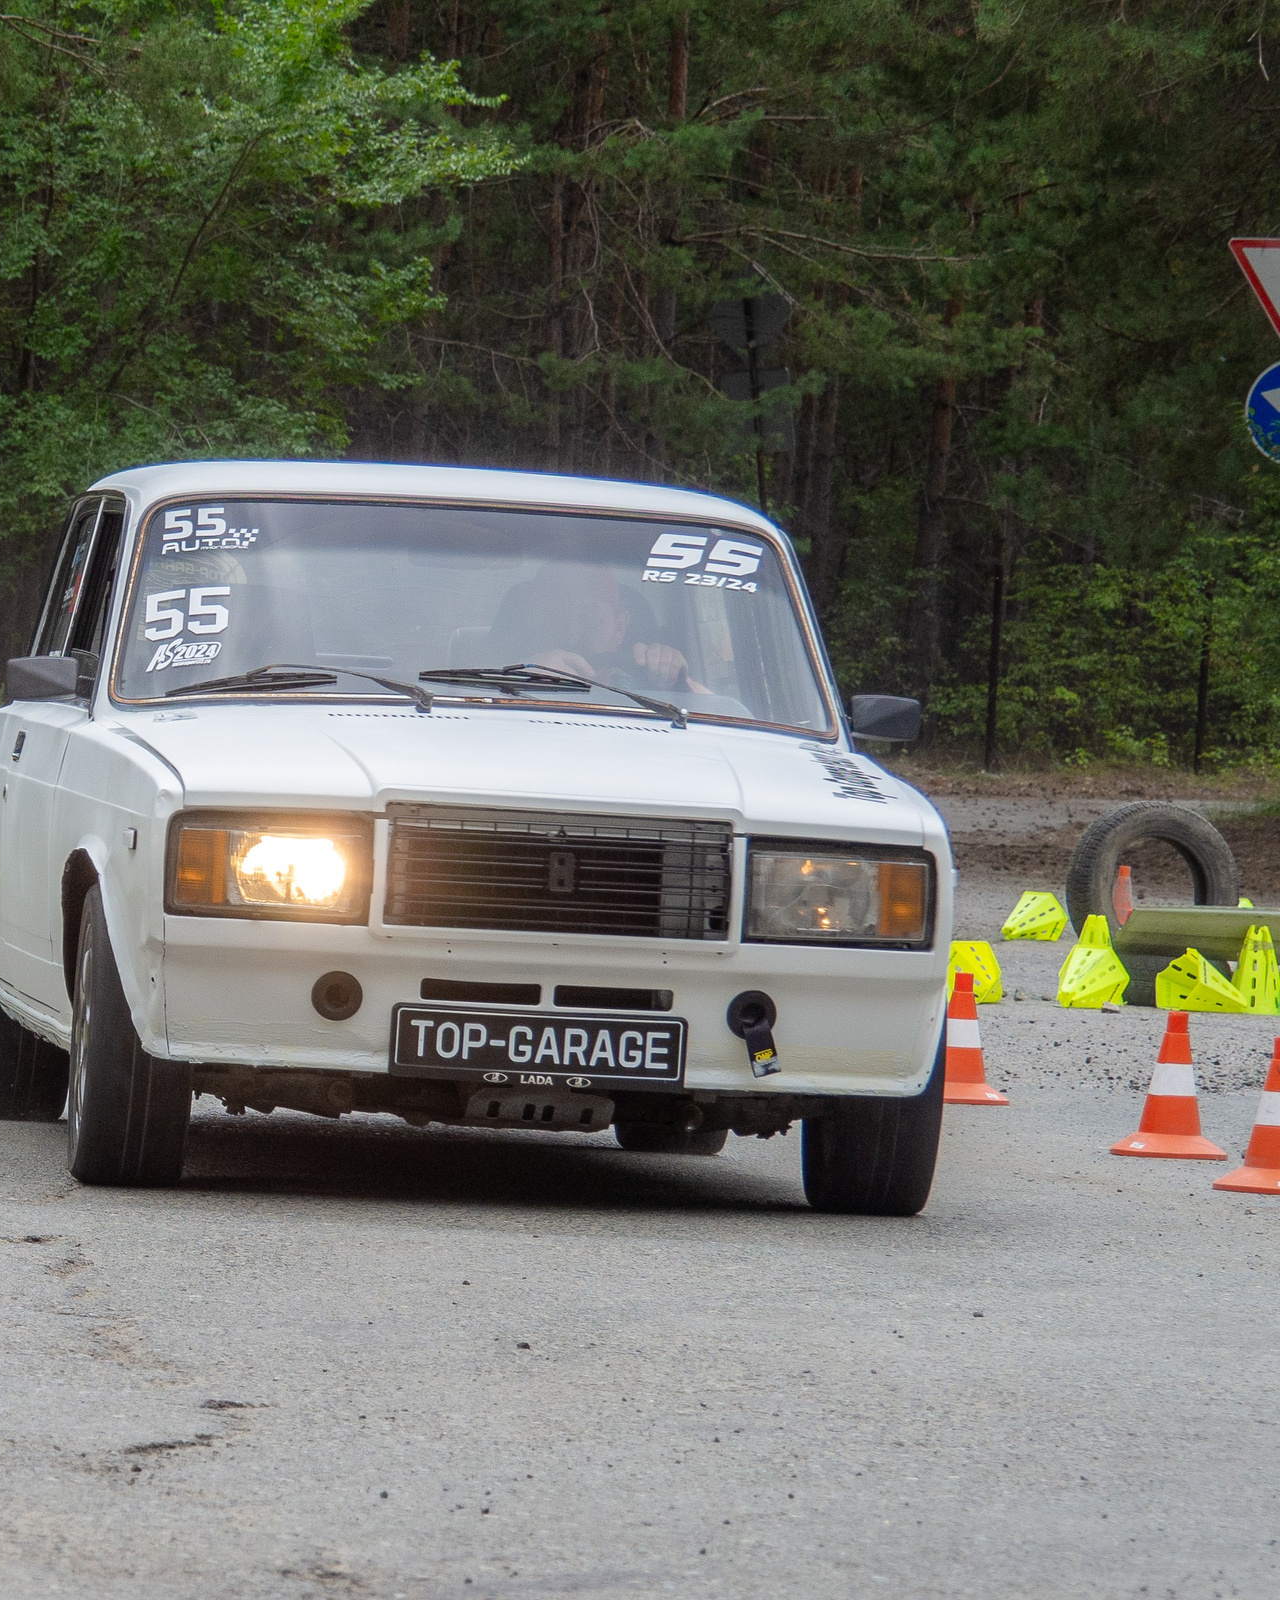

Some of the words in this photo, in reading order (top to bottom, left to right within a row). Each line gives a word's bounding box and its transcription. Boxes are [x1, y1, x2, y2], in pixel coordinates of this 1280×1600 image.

[162, 507, 227, 541] 55
[161, 537, 241, 555] AUTO
[646, 533, 763, 576] 55
[641, 569, 678, 583] RS
[683, 573, 758, 593] 23/24
[144, 586, 231, 642] 55
[410, 1018, 671, 1070] TOP-GARAGE
[520, 1073, 554, 1086] LADA
